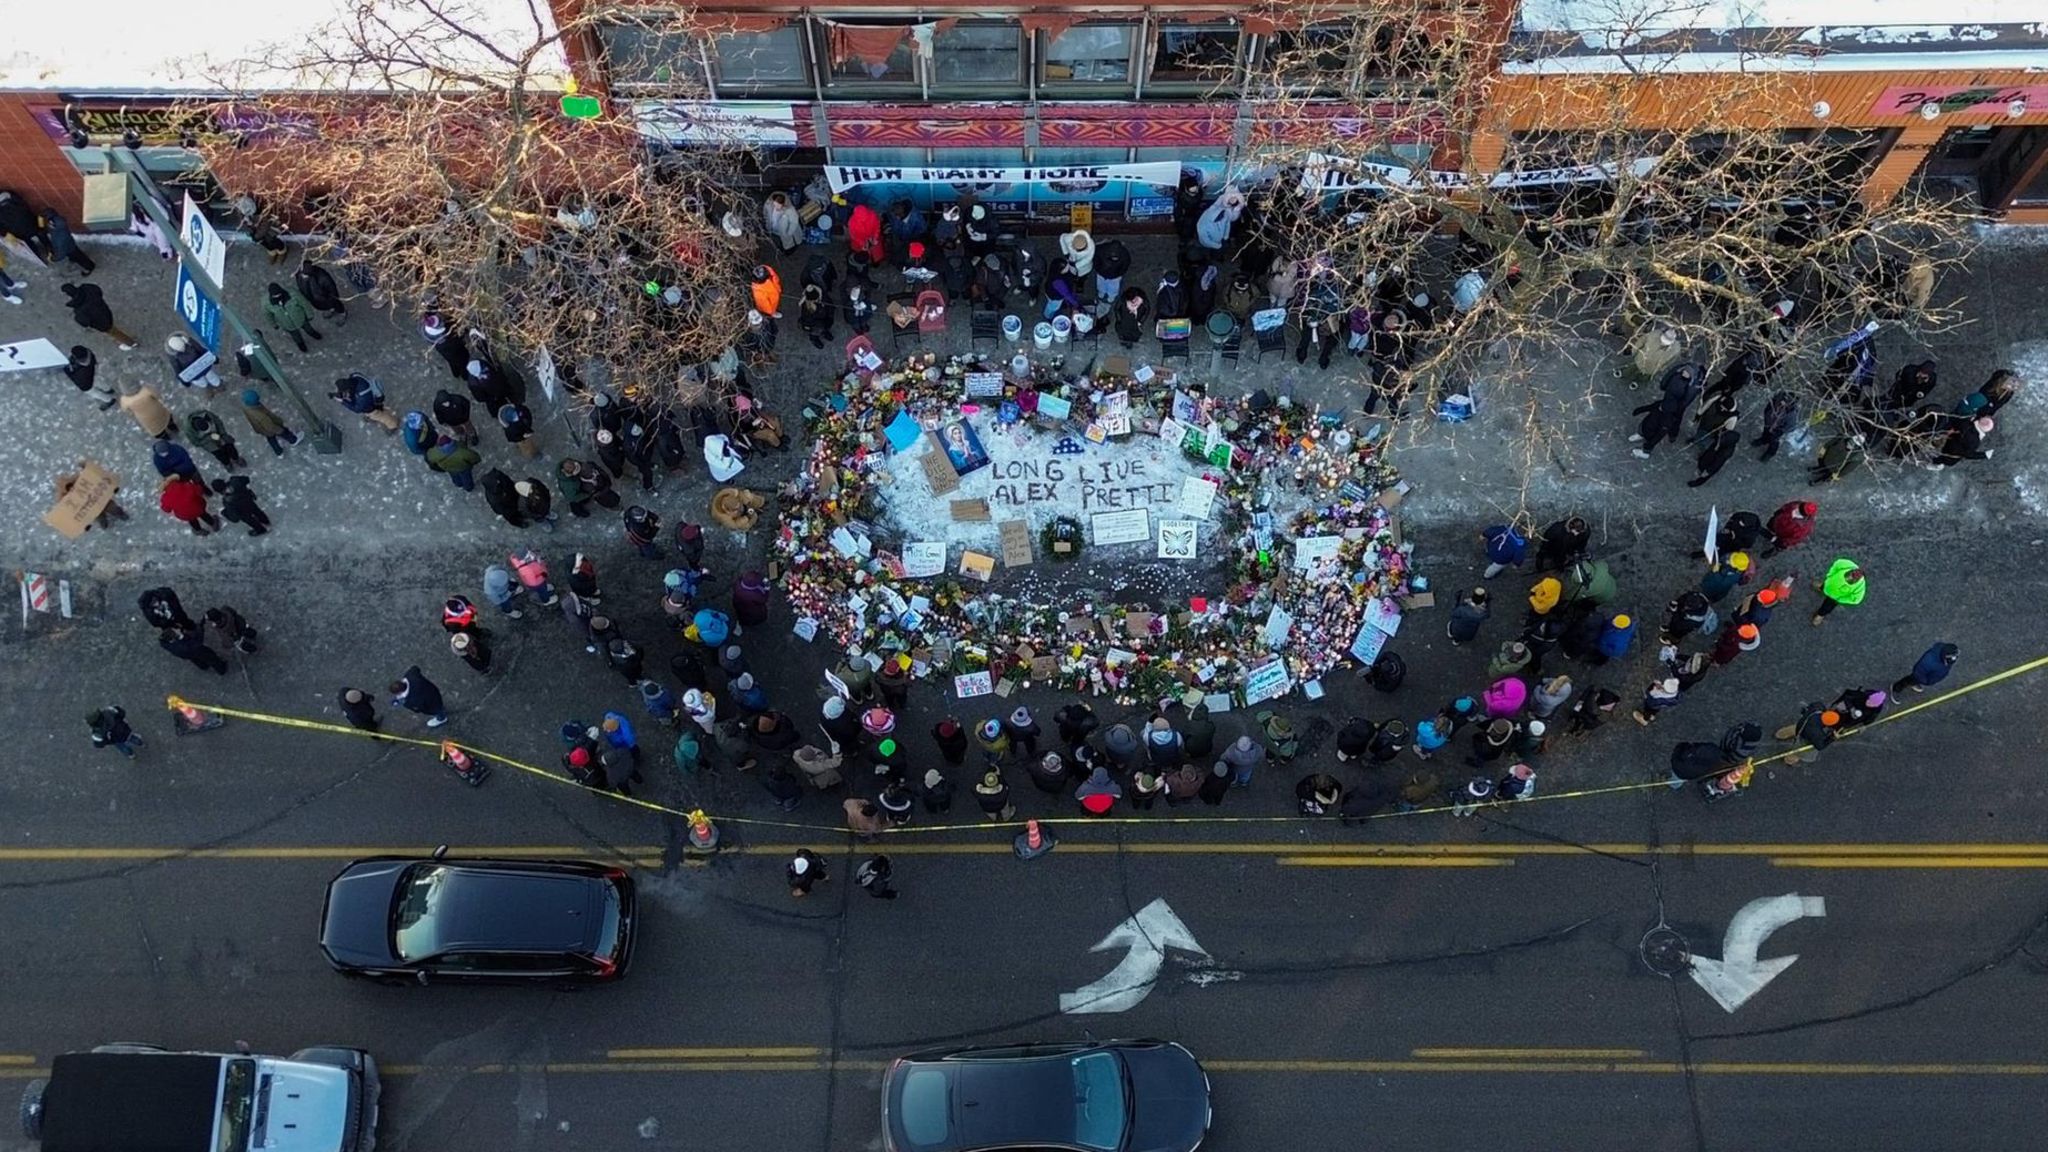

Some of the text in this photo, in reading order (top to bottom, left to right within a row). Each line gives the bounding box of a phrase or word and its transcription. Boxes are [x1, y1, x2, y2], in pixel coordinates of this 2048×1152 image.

[839, 166, 902, 184] HOW
[993, 460, 1064, 482] LONG
[994, 482, 1058, 505] ALEX
[1081, 482, 1175, 509] PRETTI
